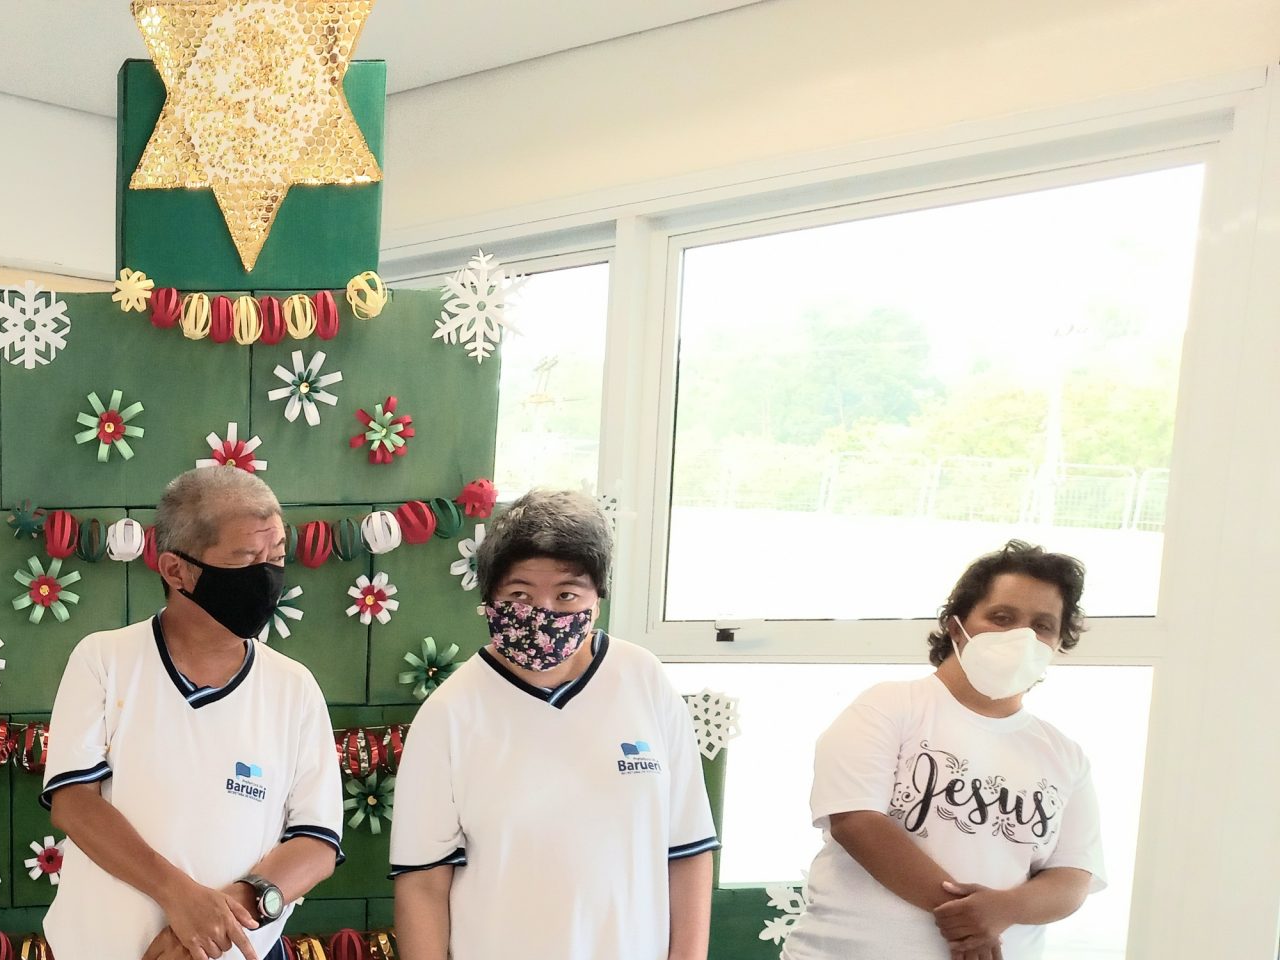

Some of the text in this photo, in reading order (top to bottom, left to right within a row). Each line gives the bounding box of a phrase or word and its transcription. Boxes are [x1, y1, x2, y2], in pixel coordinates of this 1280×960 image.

[617, 759, 662, 772] Barueri
[226, 778, 267, 800] Barueri
[904, 752, 1056, 838] Jesus
